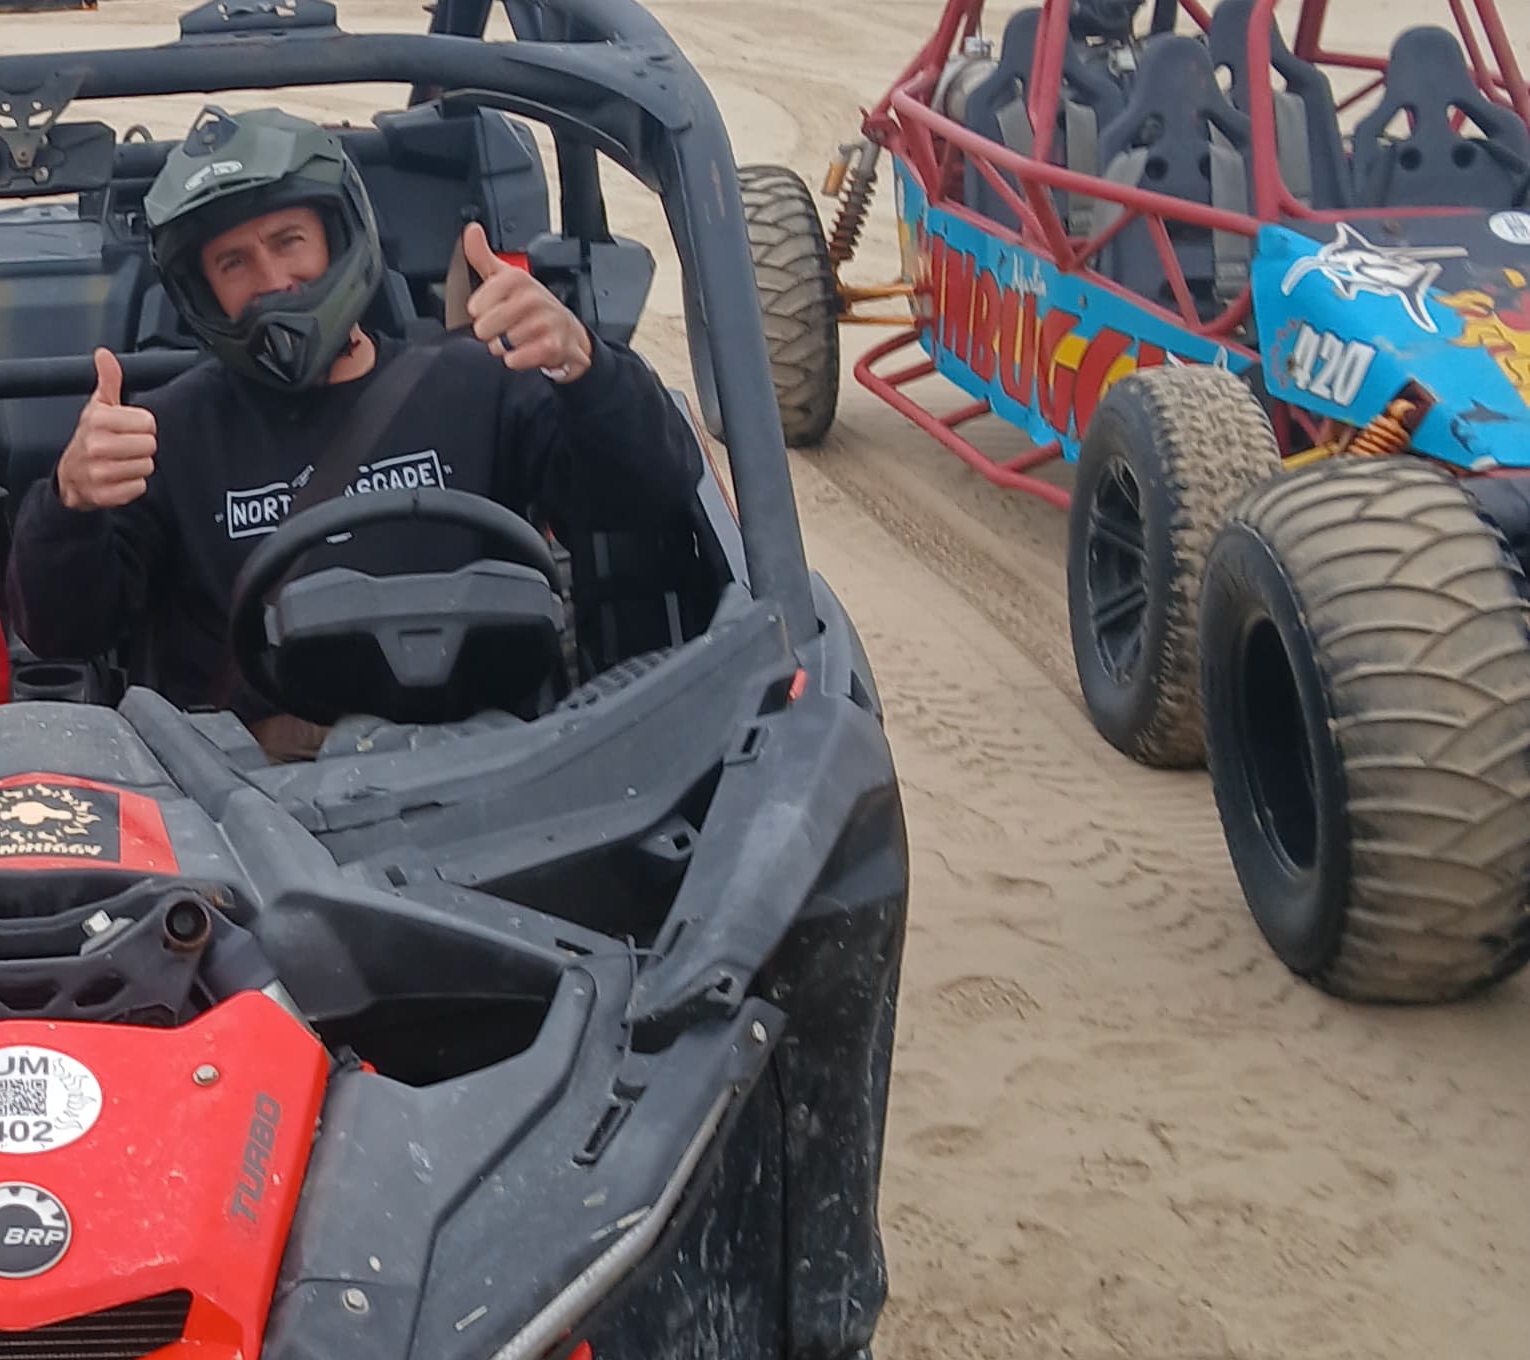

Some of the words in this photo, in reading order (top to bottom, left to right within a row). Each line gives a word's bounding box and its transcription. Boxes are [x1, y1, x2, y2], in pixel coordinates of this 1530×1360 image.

[1293, 320, 1378, 408] 420
[222, 493, 297, 527] NORT
[230, 1091, 282, 1223] TURBO
[3, 1226, 65, 1246] BRP
